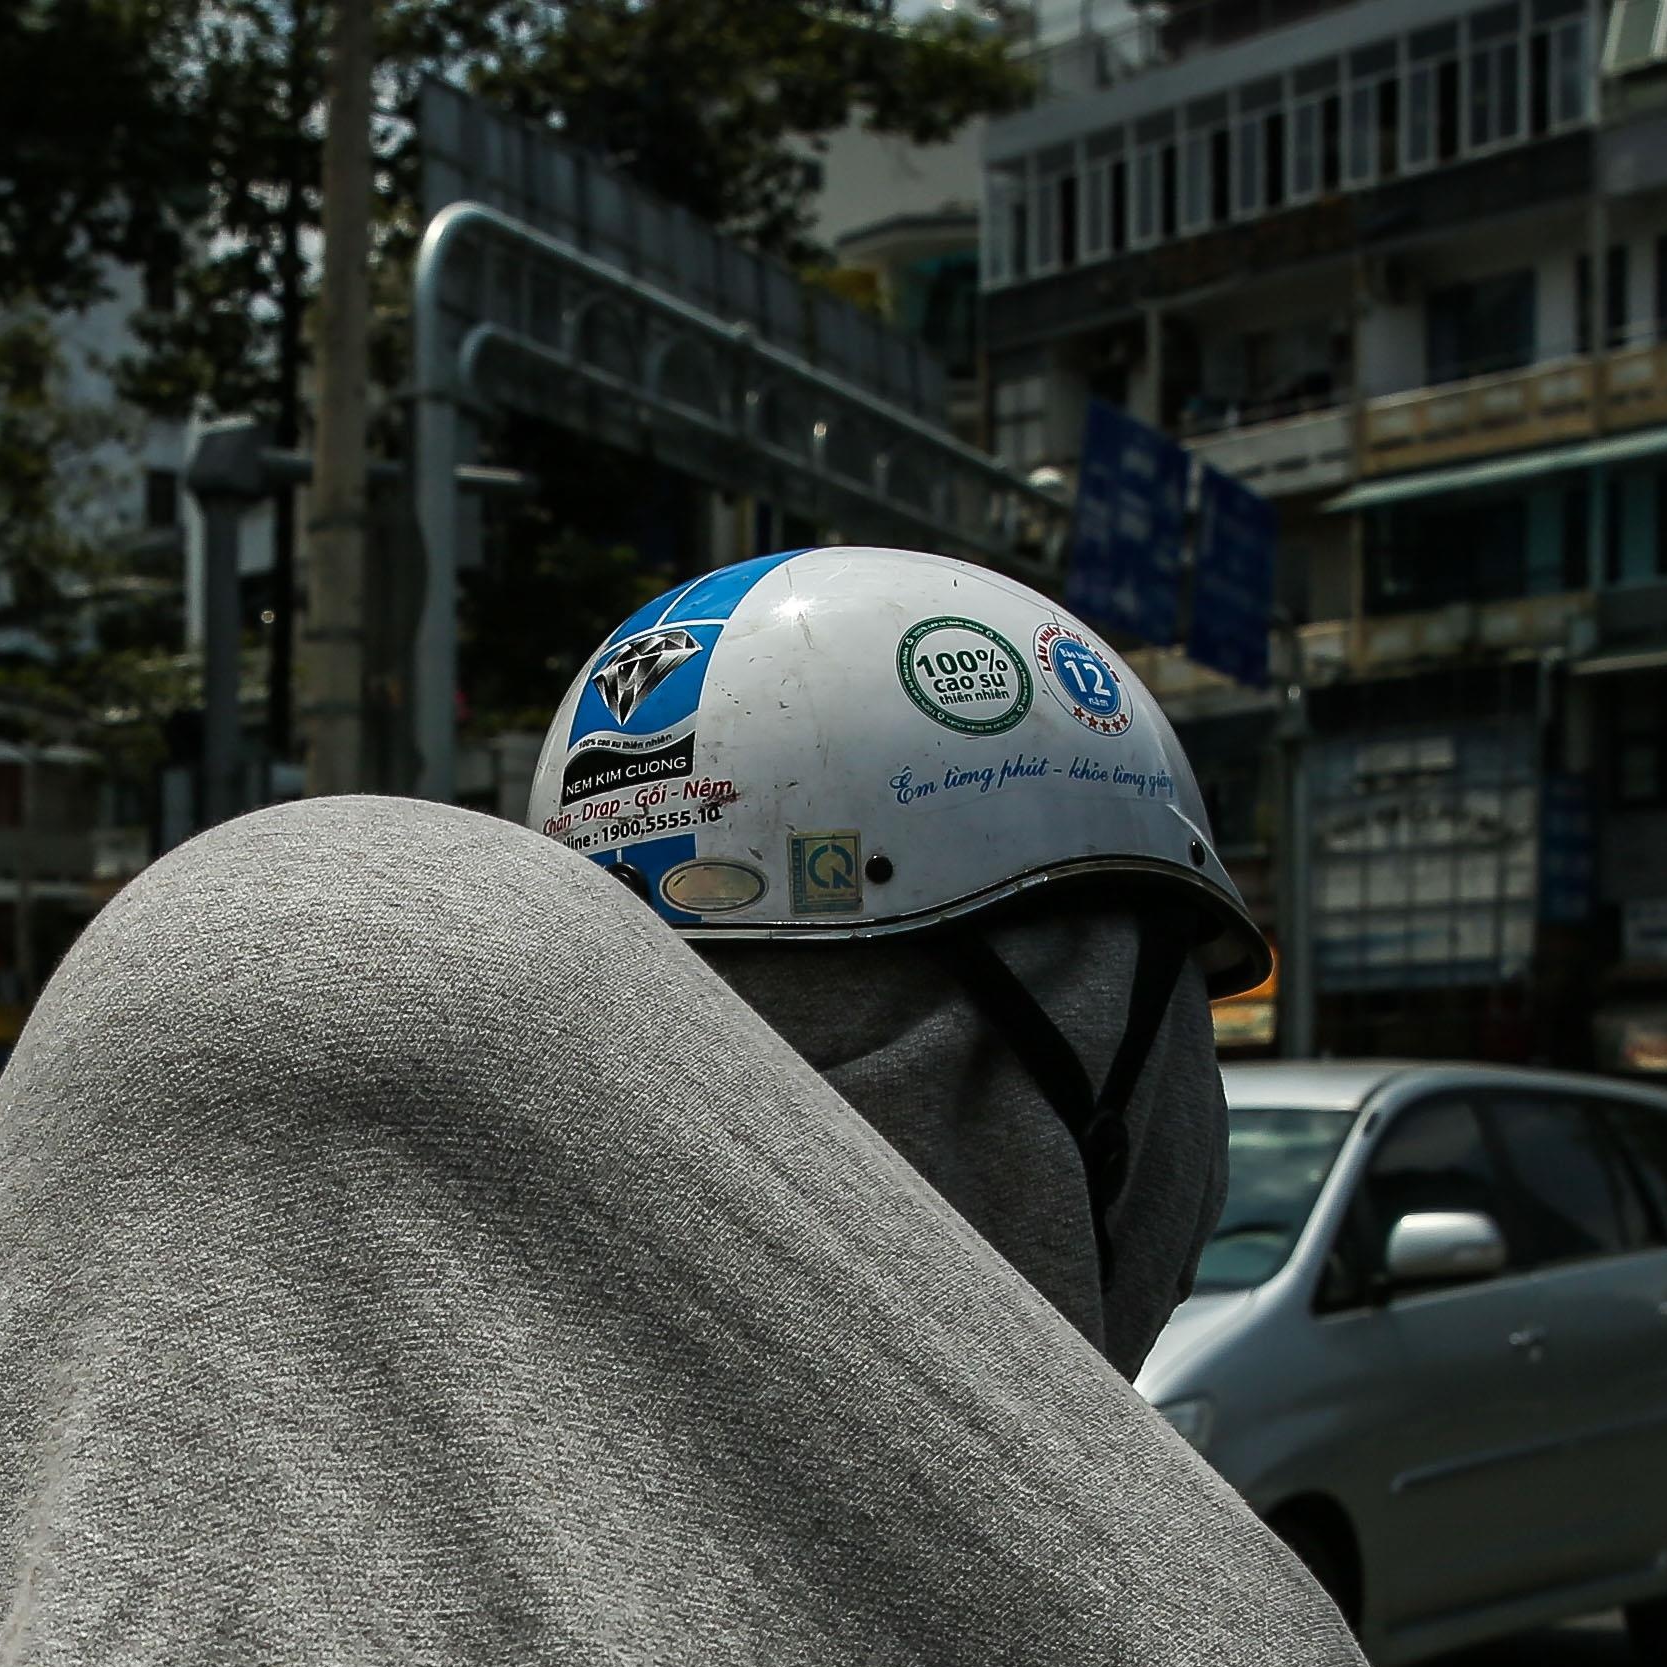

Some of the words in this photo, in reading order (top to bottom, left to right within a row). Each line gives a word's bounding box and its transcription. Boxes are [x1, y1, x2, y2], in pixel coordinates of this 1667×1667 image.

[916, 649, 1008, 678] 100%
[1063, 660, 1112, 697] 12
[933, 675, 975, 694] cao
[979, 673, 1006, 689] su
[939, 691, 973, 705] thiên
[975, 688, 1010, 701] nhiên
[645, 734, 672, 748] nhiên
[565, 776, 593, 798] NEM
[596, 768, 622, 788] KIM
[625, 756, 687, 778] CUONG
[889, 765, 937, 805] Êm
[943, 765, 995, 793] từng
[997, 753, 1050, 788] phút
[582, 800, 620, 822] Drap
[635, 783, 667, 808] Gối
[682, 777, 733, 801] Nêm
